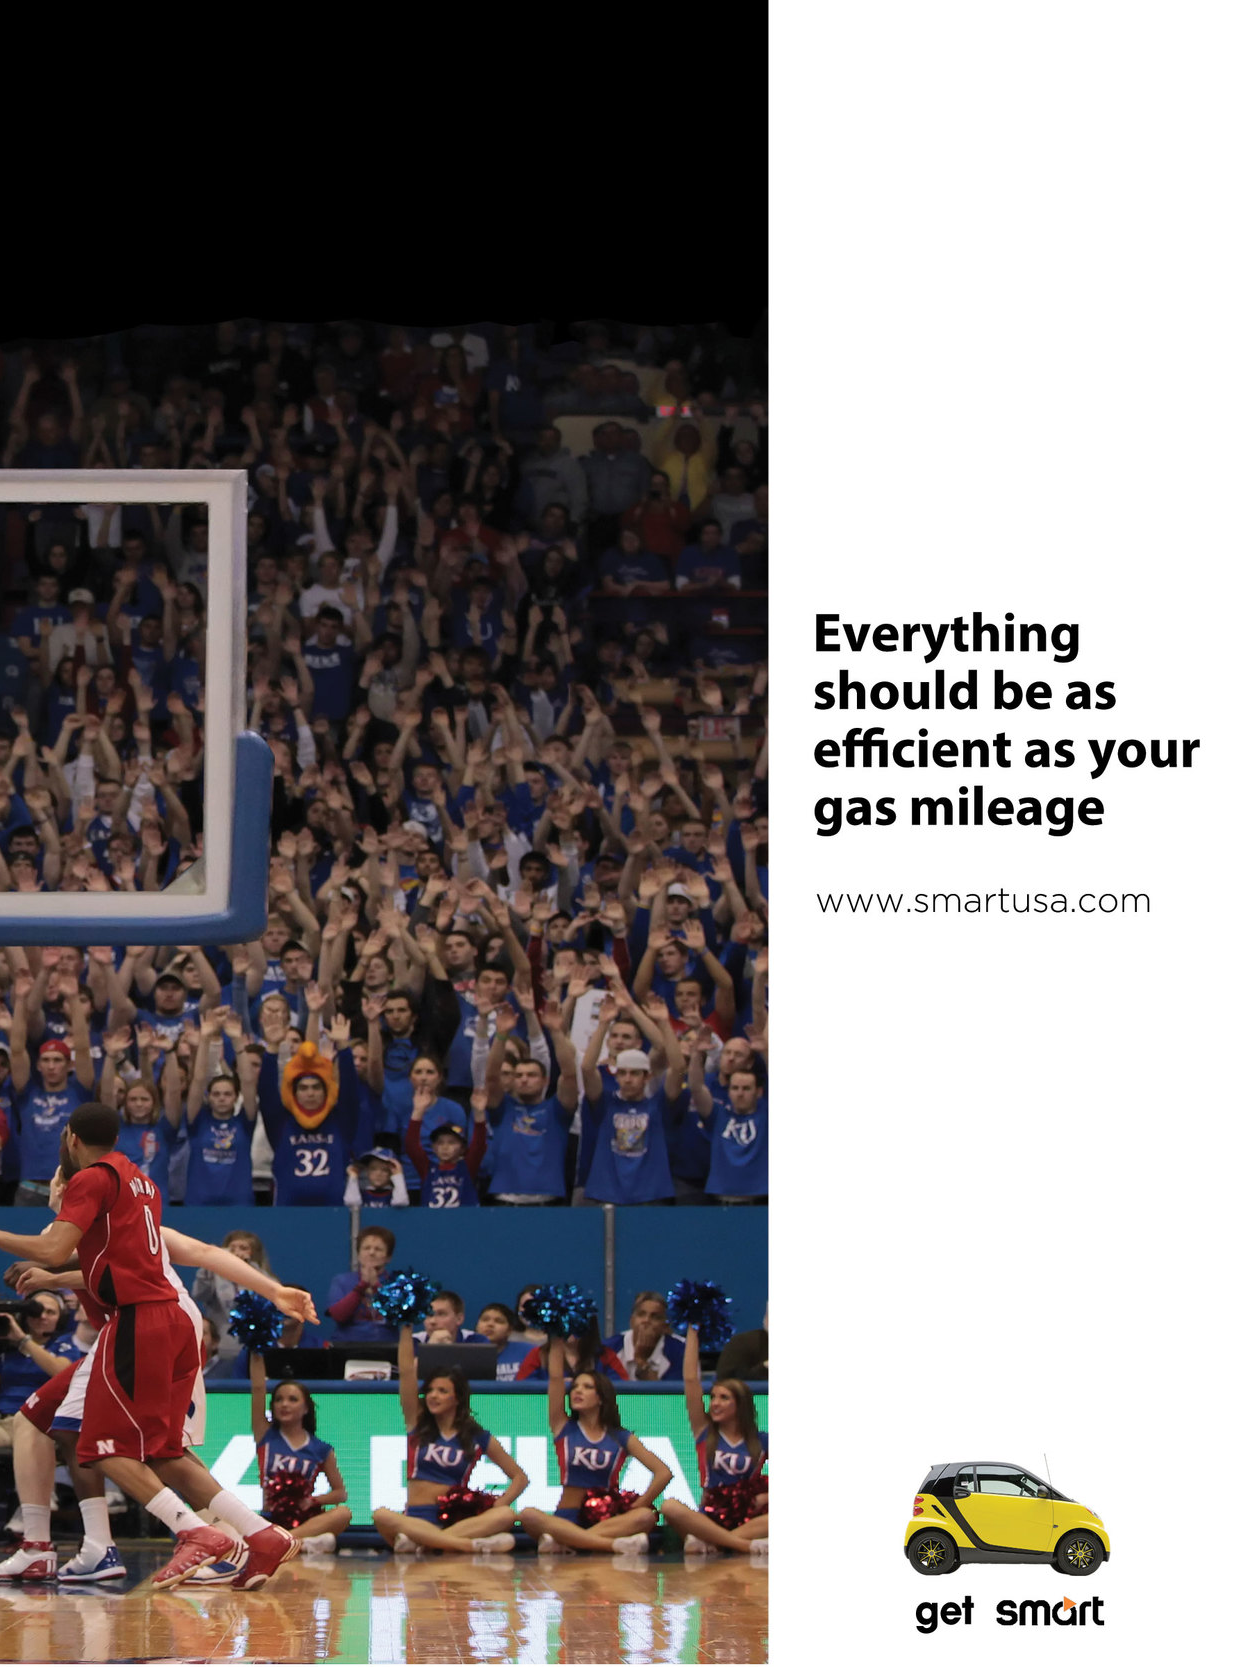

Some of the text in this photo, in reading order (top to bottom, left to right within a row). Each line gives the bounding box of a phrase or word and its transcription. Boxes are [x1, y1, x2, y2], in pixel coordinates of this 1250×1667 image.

[722, 1118, 756, 1146] KU
[294, 1149, 330, 1177] 32
[428, 1187, 460, 1208] 32
[143, 1204, 159, 1255] 0
[96, 1438, 116, 1455] N
[423, 1444, 463, 1467] KU
[571, 1446, 612, 1471] KU
[711, 1450, 752, 1475] KU
